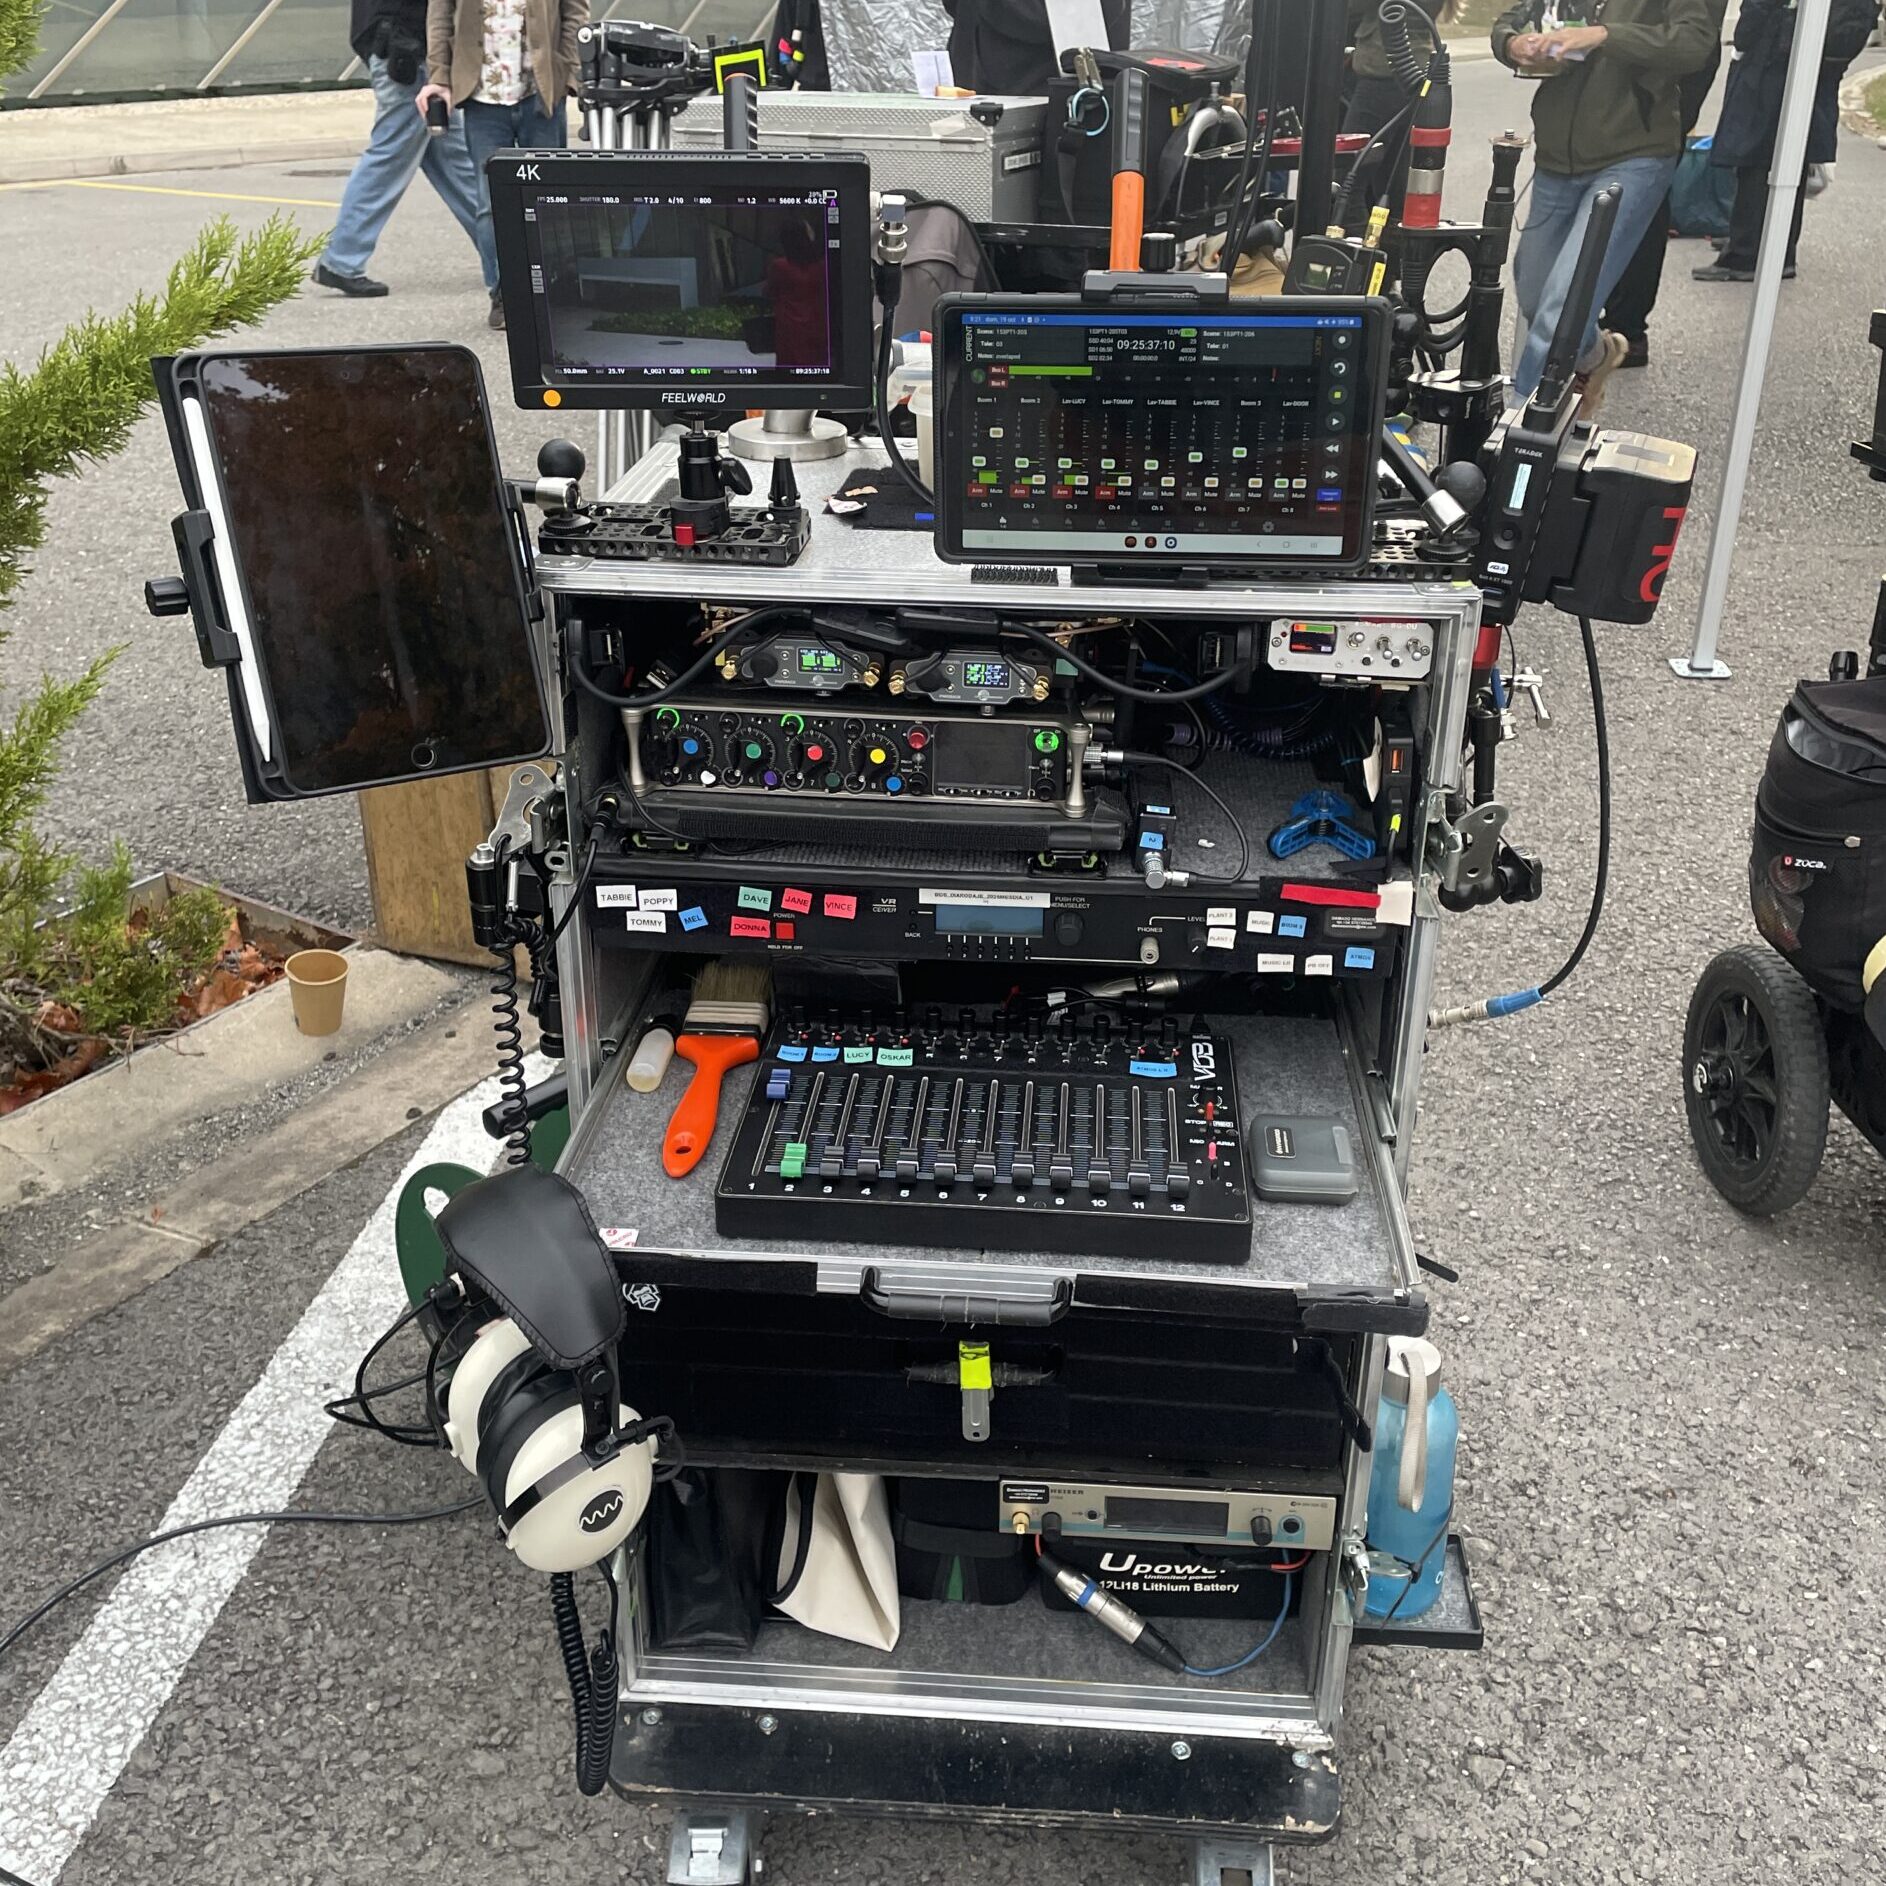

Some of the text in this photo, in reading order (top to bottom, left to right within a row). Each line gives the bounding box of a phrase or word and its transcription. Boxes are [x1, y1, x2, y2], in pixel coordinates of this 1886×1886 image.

[516, 164, 541, 180] 4K
[965, 326, 973, 362] CURRENT
[1116, 339, 1176, 351] 09:25:37:10
[661, 392, 726, 403] FEELWORLD
[601, 893, 633, 902] TABBIE
[643, 897, 674, 906] POPPY
[743, 894, 769, 905] DAVE
[784, 896, 809, 907] JANE
[825, 901, 853, 912] VINCE
[630, 918, 663, 928] TOMMY
[683, 915, 703, 925] MEL
[733, 923, 767, 932] DONNA
[846, 1051, 870, 1059] LUCY
[748, 1182, 756, 1191] 1
[784, 1184, 795, 1192] 2
[822, 1185, 833, 1193] 3
[860, 1187, 872, 1196] 4
[899, 1189, 910, 1197] 5
[938, 1191, 949, 1199] 6
[977, 1193, 988, 1201] 7
[1055, 1197, 1065, 1205] 9
[1090, 1199, 1108, 1207] 10
[1131, 1201, 1145, 1209] 11
[1170, 1203, 1186, 1212] 12
[1100, 1552, 1226, 1576] Upow
[1142, 1582, 1191, 1592] Lithium
[1193, 1583, 1240, 1593] Battery
